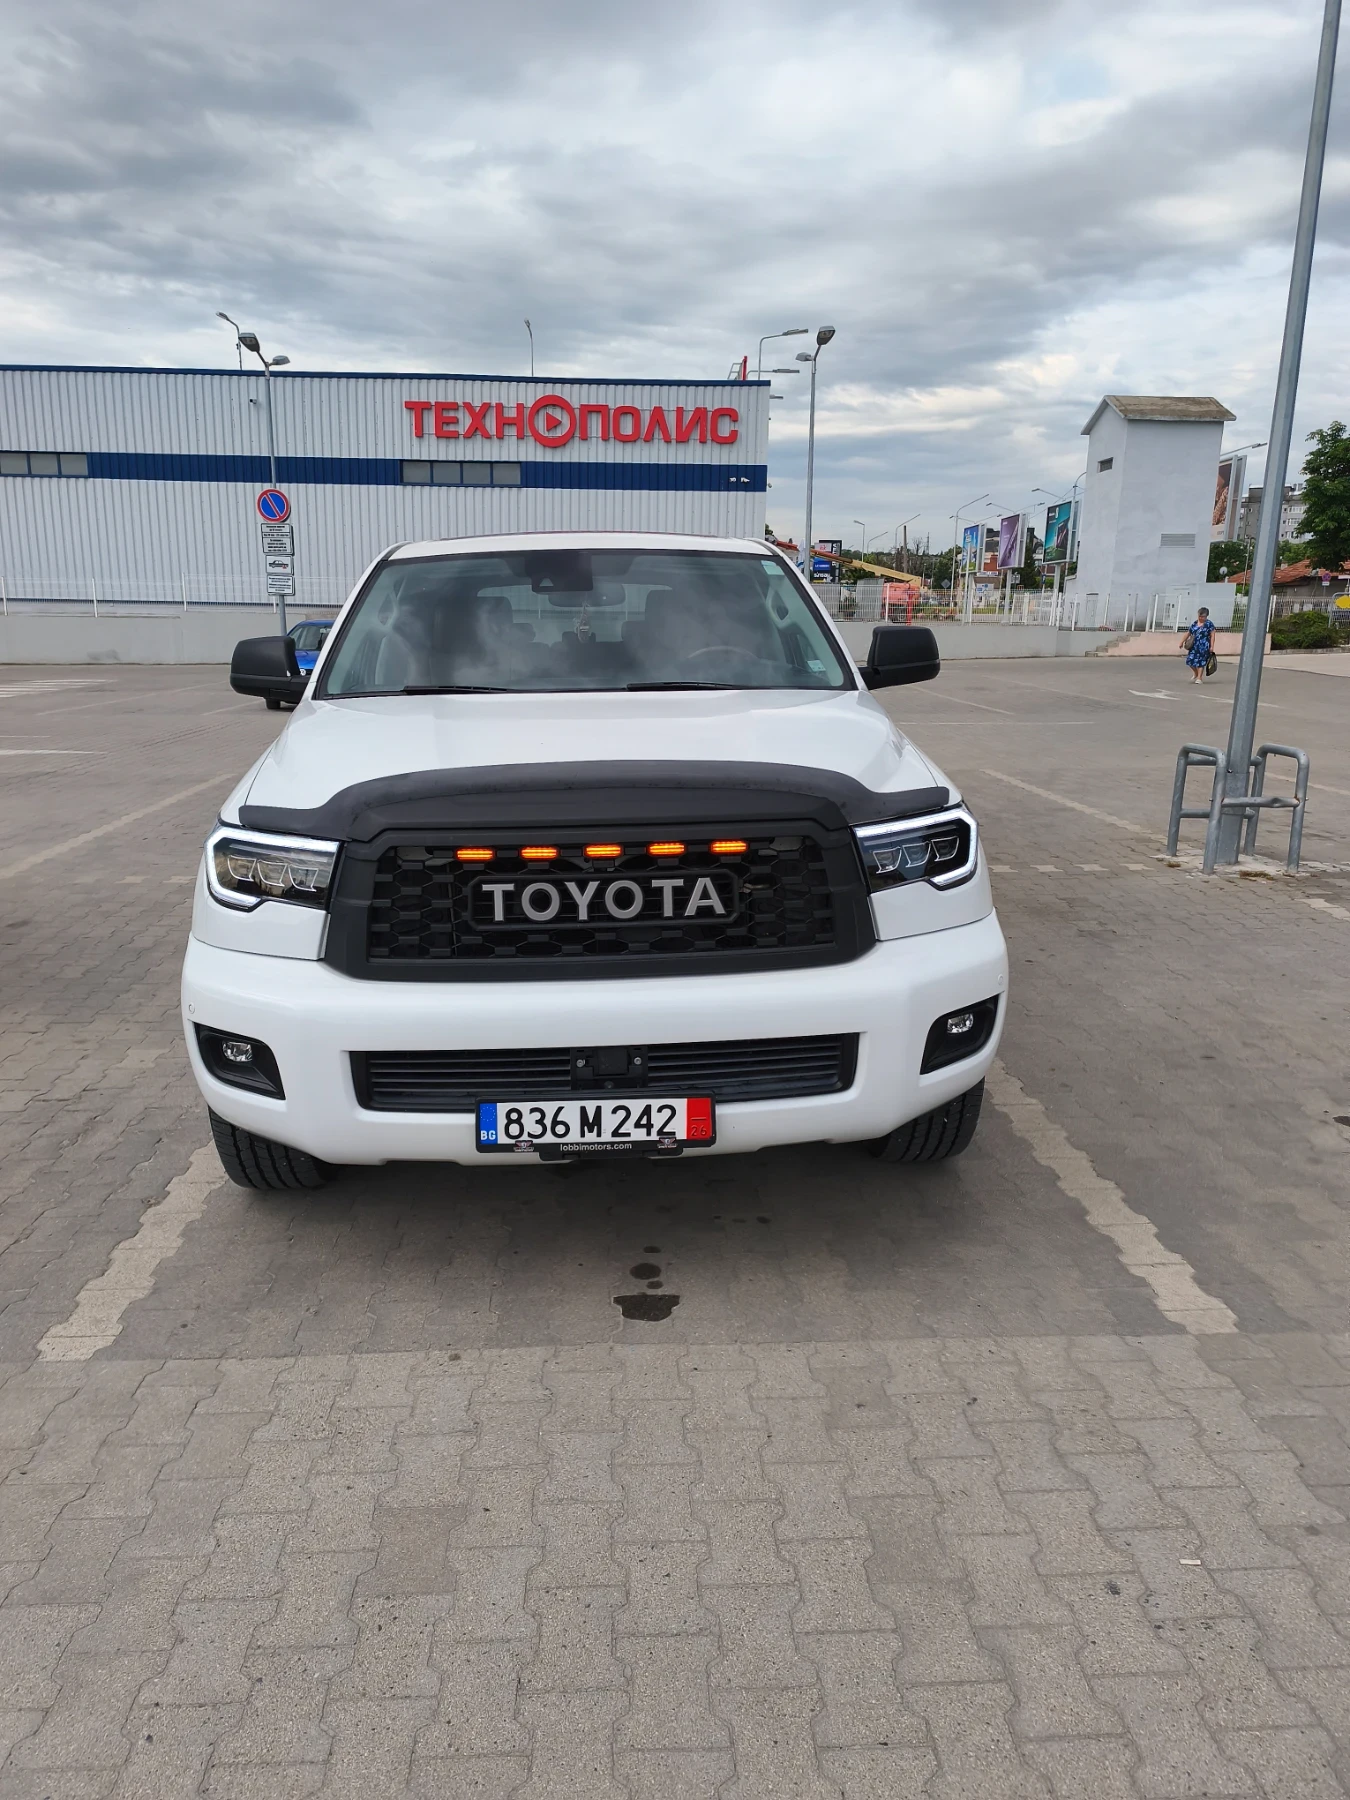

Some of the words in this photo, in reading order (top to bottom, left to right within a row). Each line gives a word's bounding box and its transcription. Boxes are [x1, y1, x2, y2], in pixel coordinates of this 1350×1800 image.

[404, 395, 738, 447] ТЕХНОПОЛИС
[481, 877, 726, 922] TOYOTA
[504, 1106, 571, 1139] 836
[611, 1104, 677, 1138] 242
[691, 1125, 708, 1136] 26
[480, 1130, 496, 1140] BG
[560, 1143, 632, 1151] lobbimotors.com
